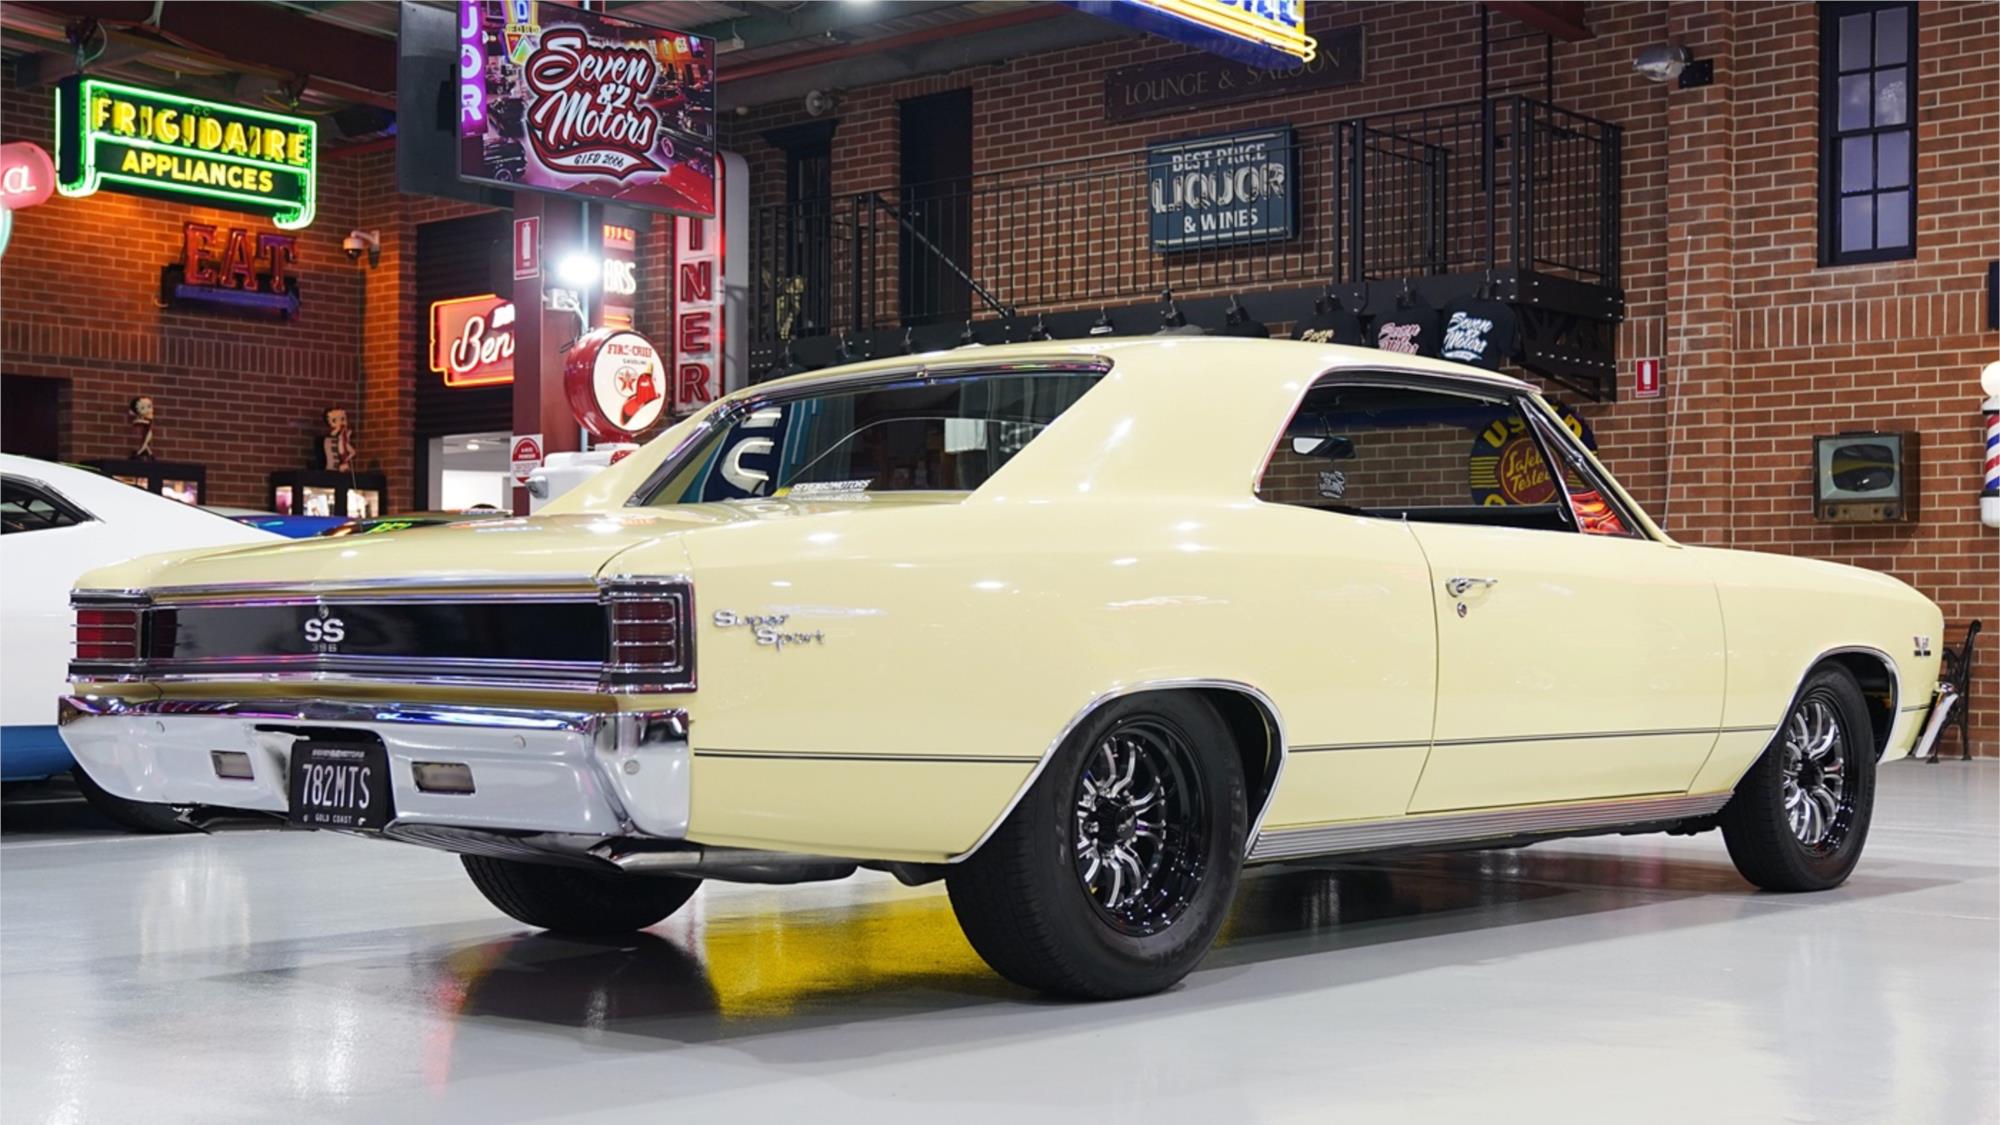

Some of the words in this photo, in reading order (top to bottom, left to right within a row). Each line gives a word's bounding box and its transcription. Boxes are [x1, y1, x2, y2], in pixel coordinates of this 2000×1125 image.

[531, 36, 650, 91] Seven
[596, 82, 631, 109] 82
[1125, 71, 1209, 106] LOUNGE
[1218, 69, 1234, 89] &
[91, 97, 309, 168] FRIGIDAIRE
[534, 90, 652, 145] Motors
[121, 150, 274, 194] APPLIANCES
[1172, 150, 1213, 173] BEST
[1215, 143, 1267, 166] PRICE
[1151, 162, 1286, 214] LIQUOR
[1183, 215, 1197, 234] &
[1200, 207, 1259, 232] WINES
[181, 221, 297, 293] EAT
[1447, 311, 1494, 333] Seven
[1443, 330, 1488, 354] Motors
[304, 618, 345, 643] SS
[713, 609, 790, 635] Super
[756, 626, 825, 653] Sport
[302, 764, 372, 810] 782MTS
[314, 812, 330, 823] GOLD
[332, 814, 353, 825] COAST
